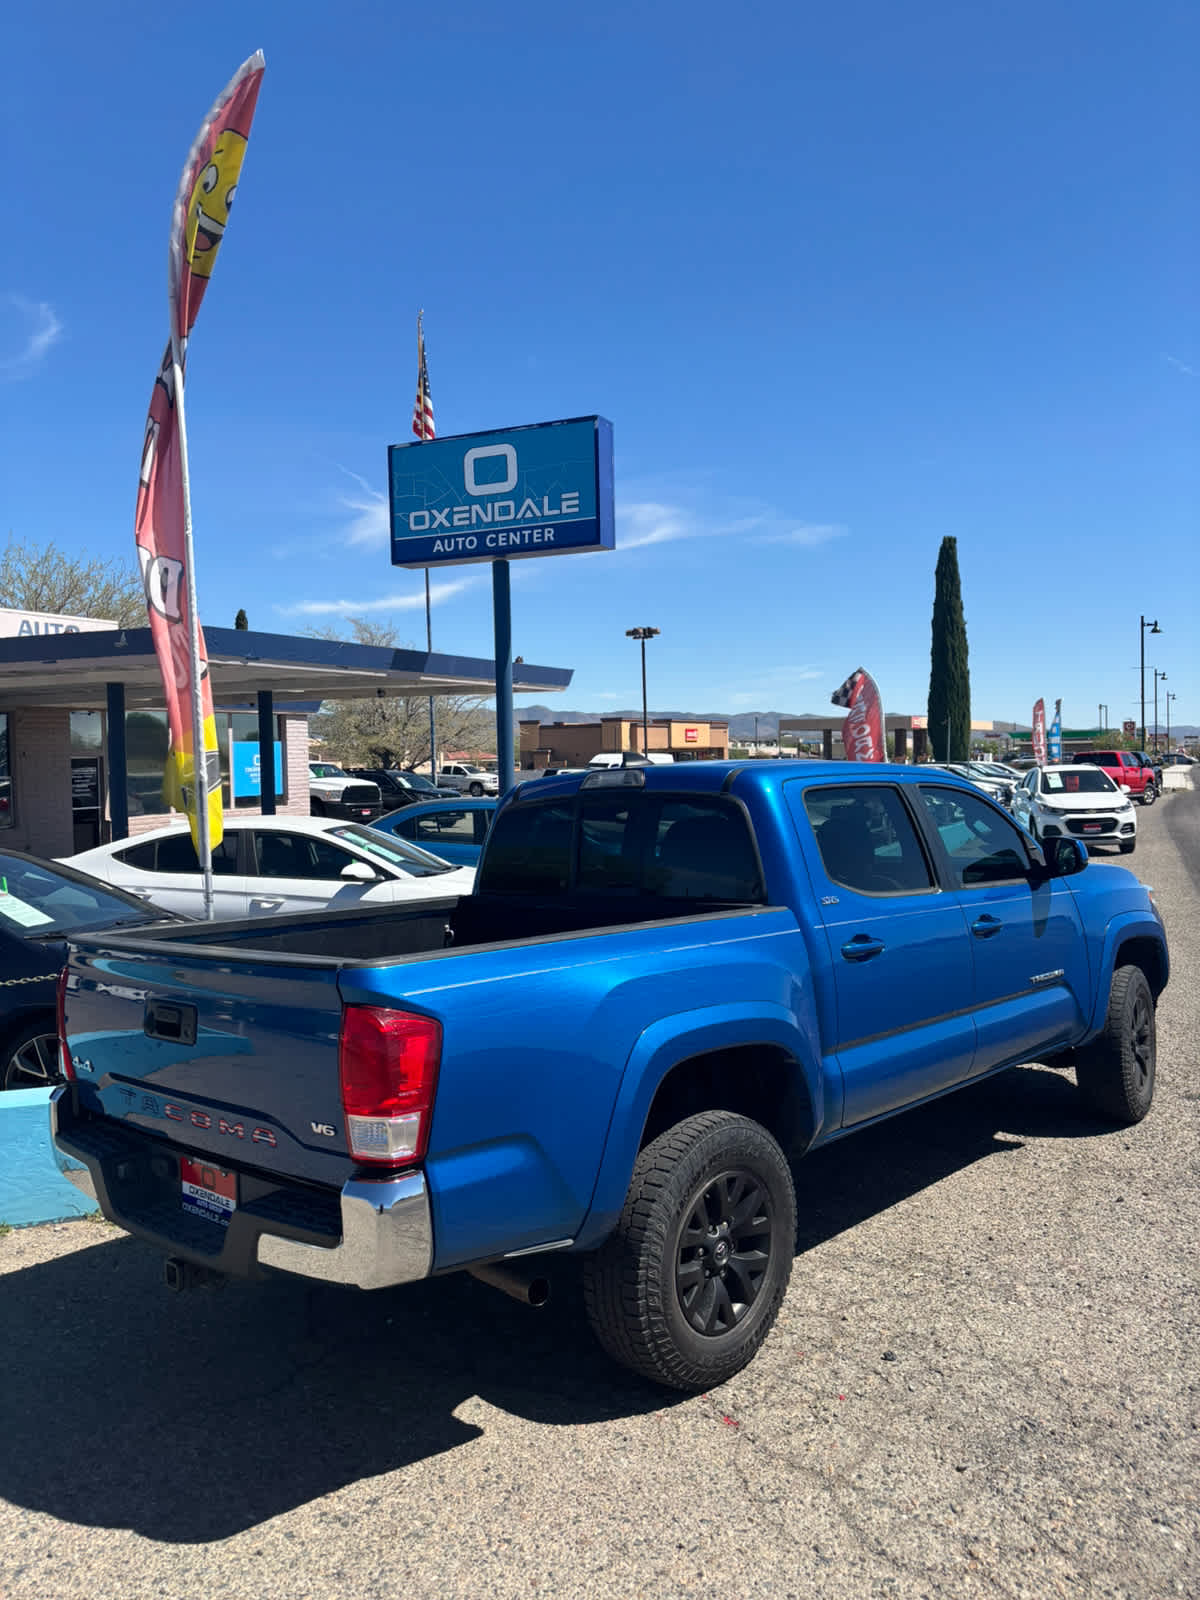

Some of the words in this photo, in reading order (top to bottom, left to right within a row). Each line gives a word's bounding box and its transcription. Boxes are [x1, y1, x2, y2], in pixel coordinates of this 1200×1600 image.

[409, 491, 580, 531] OXENDALE
[433, 536, 478, 553] AUTO
[486, 528, 555, 548] CENTER
[119, 1087, 278, 1148] TACOMA
[311, 1121, 336, 1137] V6
[188, 1185, 232, 1210] OXENDALE
